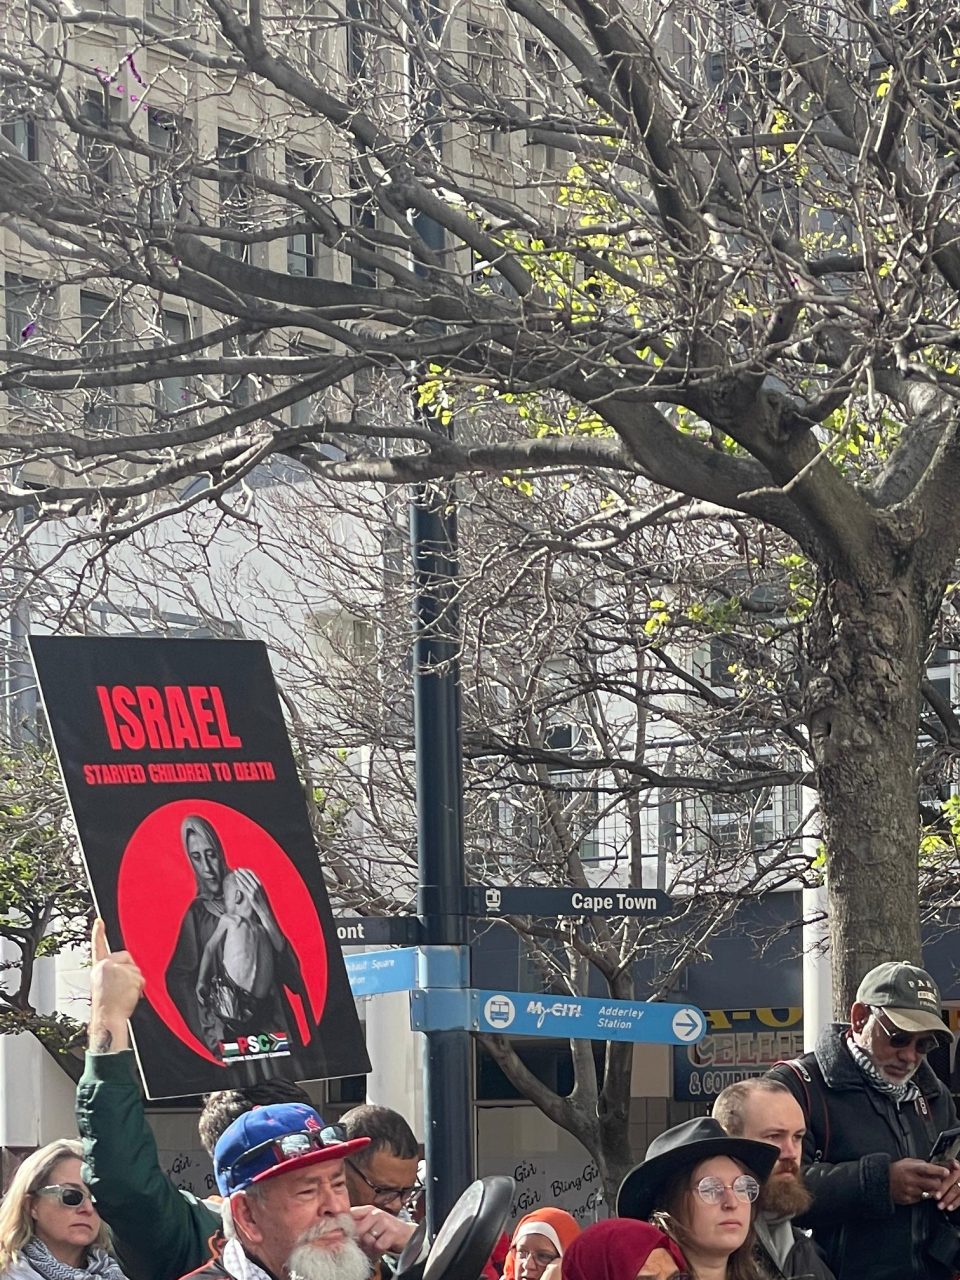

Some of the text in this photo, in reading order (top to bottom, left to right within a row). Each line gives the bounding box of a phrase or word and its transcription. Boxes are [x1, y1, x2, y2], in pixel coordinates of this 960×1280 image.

[97, 685, 242, 750] ISRAEL
[83, 762, 276, 785] STARVED CHILDREN TO DEATH
[571, 893, 657, 912] Cape Town
[336, 923, 365, 939] ont
[598, 1006, 644, 1020] Adderley
[597, 1018, 632, 1029] Station
[237, 1034, 270, 1054] PSC
[551, 1177, 582, 1197] Bling
